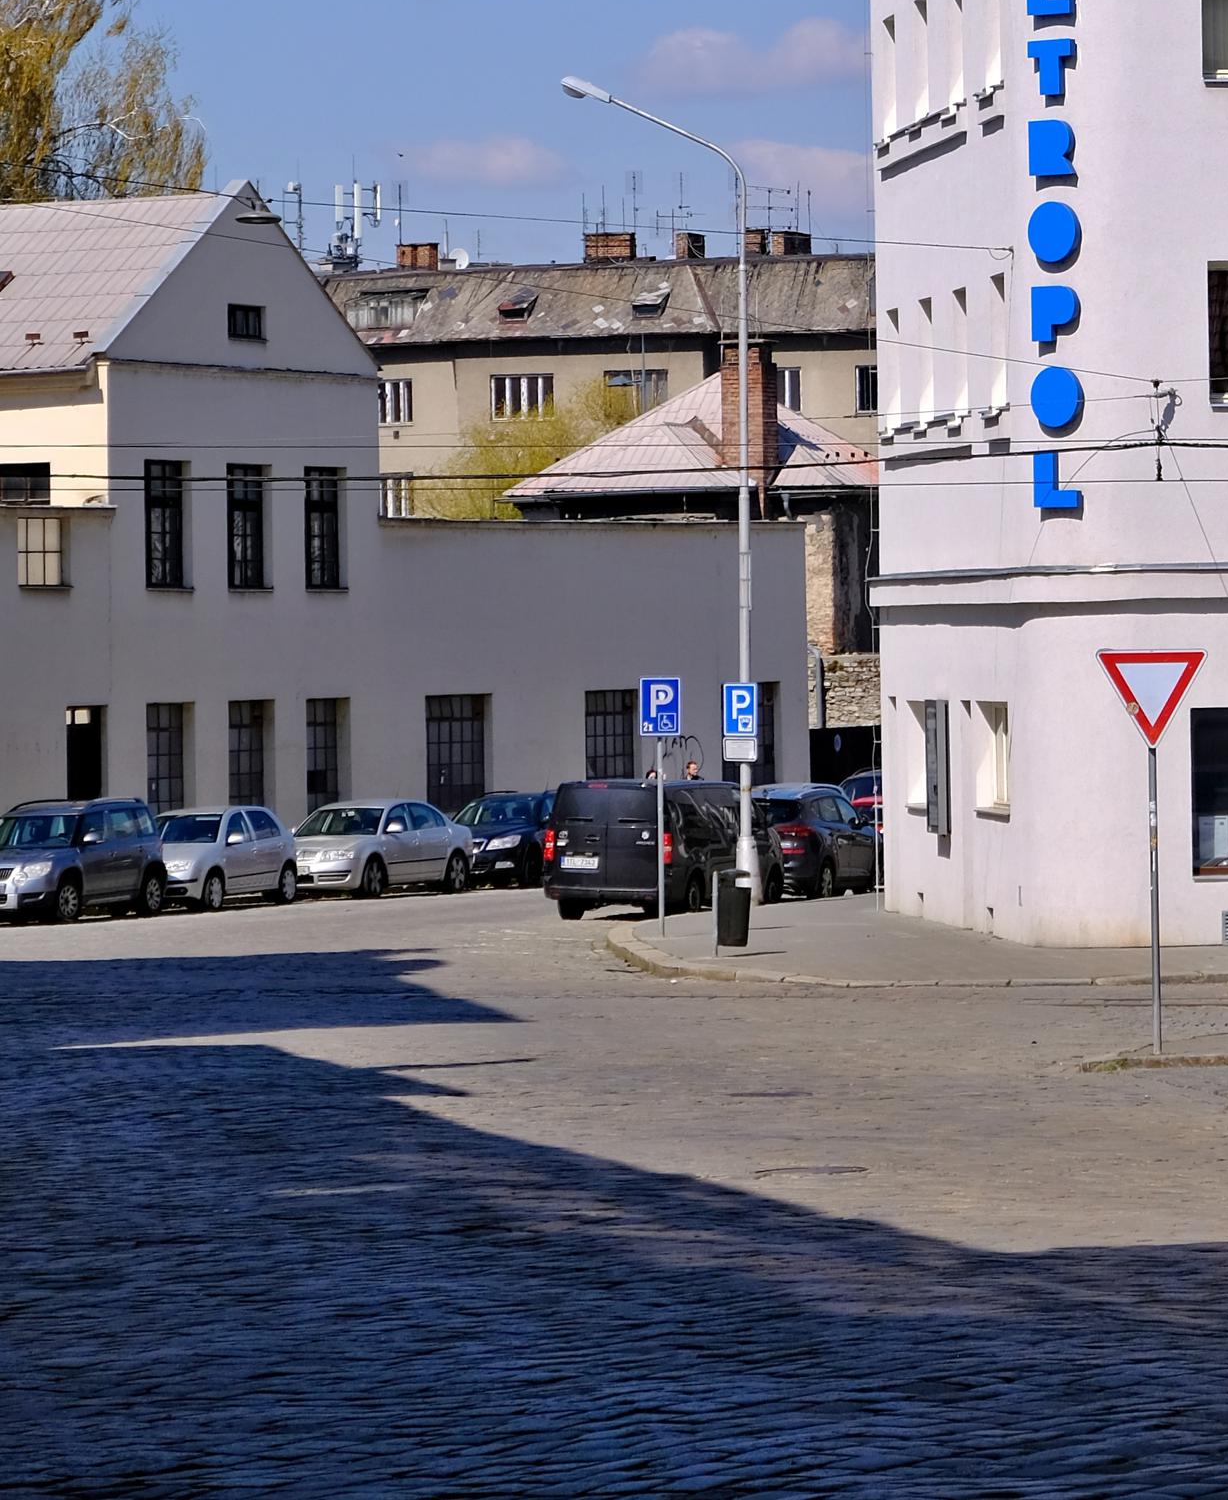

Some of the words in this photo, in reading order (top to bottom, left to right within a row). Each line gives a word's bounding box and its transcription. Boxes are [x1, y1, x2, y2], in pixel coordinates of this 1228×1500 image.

[650, 684, 674, 718] P
[731, 690, 750, 719] P
[642, 721, 654, 732] 2x
